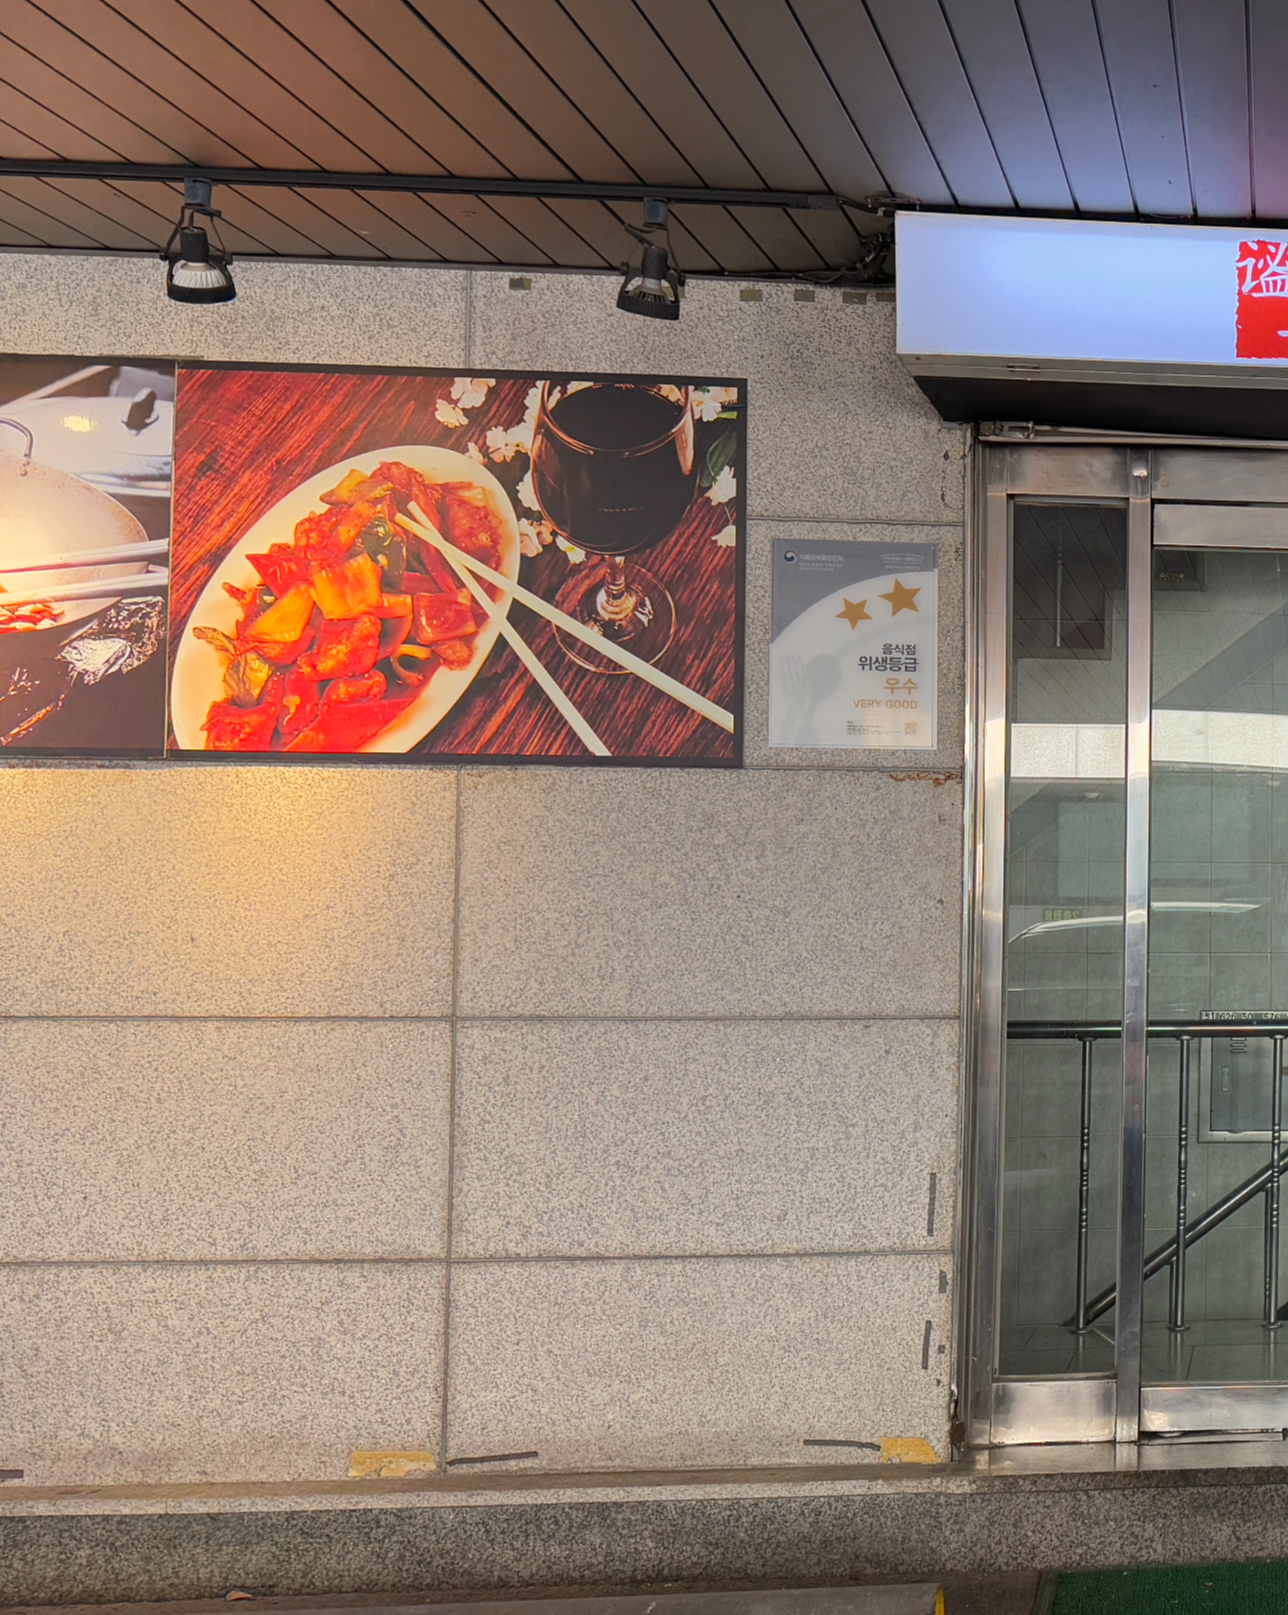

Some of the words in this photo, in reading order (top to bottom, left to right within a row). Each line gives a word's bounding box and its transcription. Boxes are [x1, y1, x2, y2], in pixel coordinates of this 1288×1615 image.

[881, 643, 916, 655] 음식점
[858, 656, 919, 672] 위생등급
[884, 677, 918, 695] 우수
[853, 699, 882, 708] VERY
[885, 700, 918, 709] GOOD
